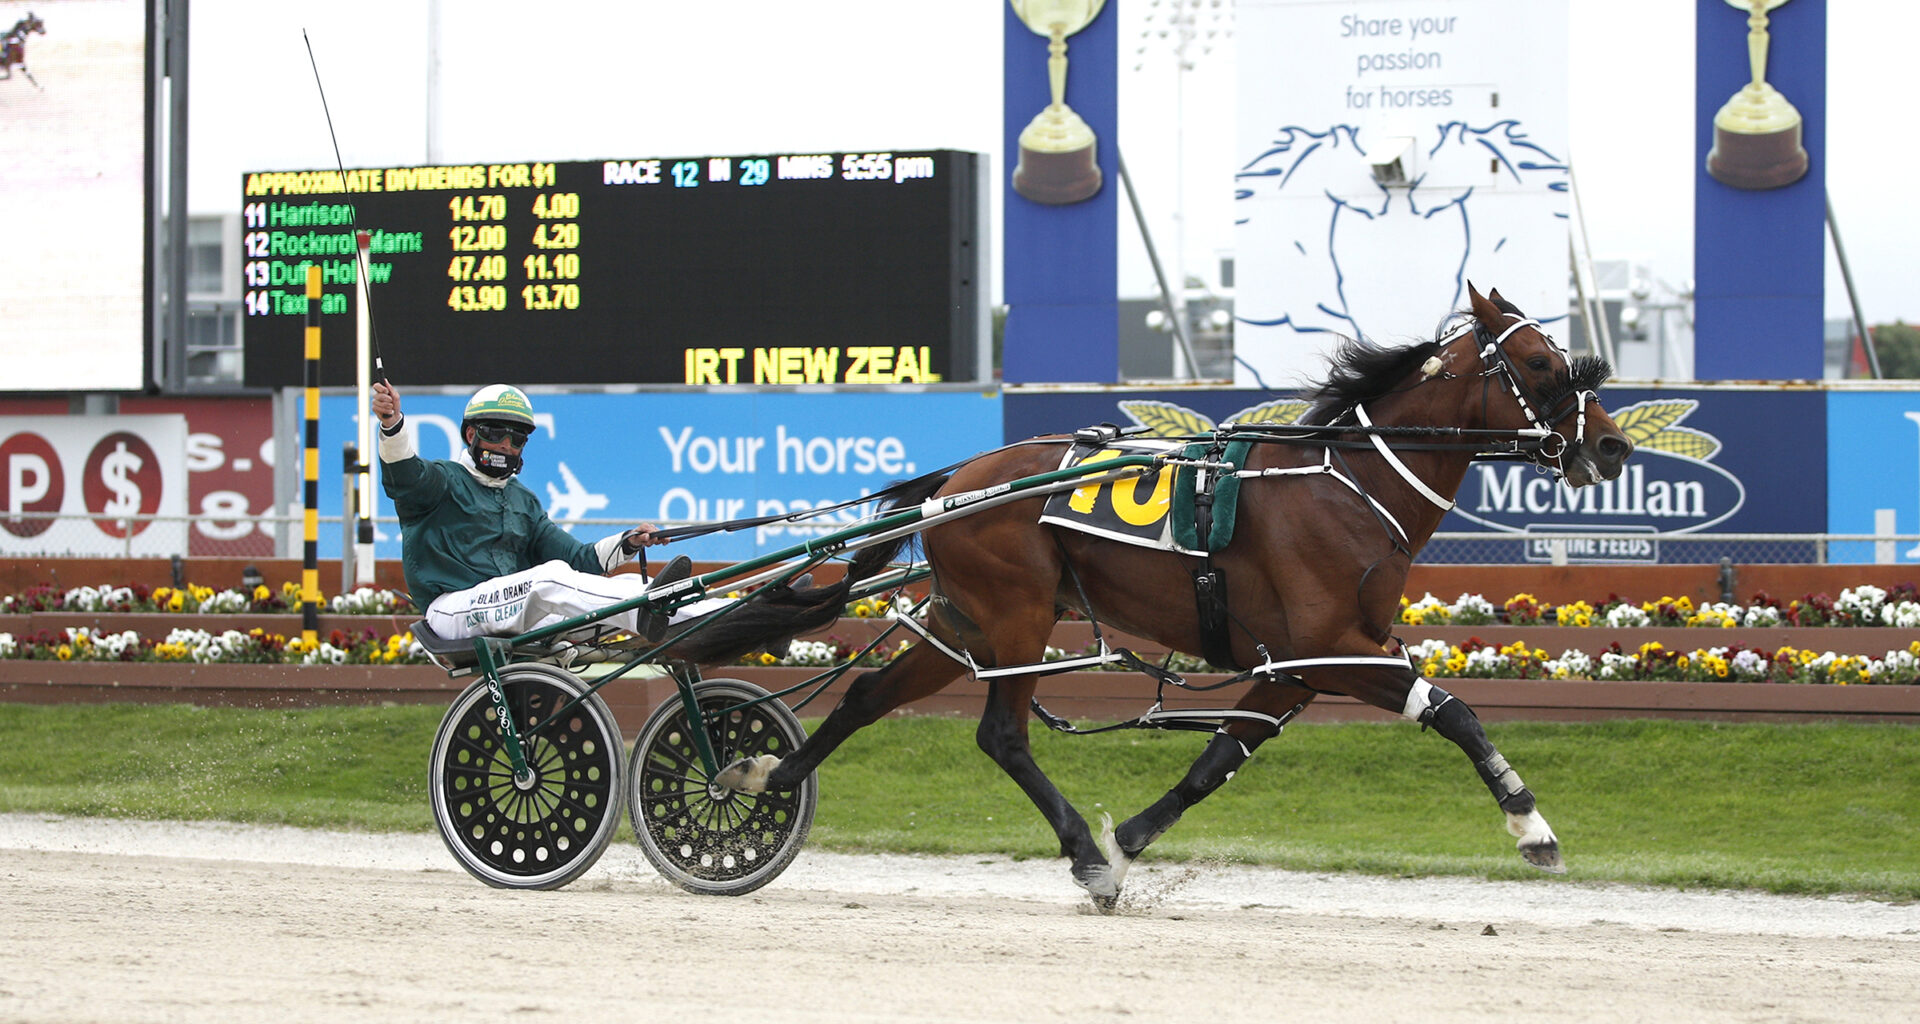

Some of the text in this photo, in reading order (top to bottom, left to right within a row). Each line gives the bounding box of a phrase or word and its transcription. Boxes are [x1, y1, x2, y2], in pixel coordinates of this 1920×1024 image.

[1340, 15, 1458, 40] Share your
[1357, 49, 1442, 77] passion
[1346, 85, 1453, 109] for horses
[246, 162, 556, 197] APPROXIMATE DIVIDENDS FOR $1
[603, 153, 934, 187] RACE 12 IN 29 MINS 5:55 pm
[245, 193, 580, 228] 11 Harrison 14.70 4.00
[245, 232, 270, 257] 12
[450, 225, 507, 251] 12.00
[532, 223, 580, 249] 4.20
[245, 261, 270, 286] 13
[323, 257, 393, 284] Holw
[448, 255, 507, 281] 47.40
[523, 253, 580, 280] 11.10
[245, 284, 580, 316] 14 Taxan 43.90 13.70
[684, 347, 744, 385] IRT
[753, 347, 839, 385] NEW
[659, 425, 916, 475] Your horse.
[9, 453, 50, 524] P
[1068, 449, 1173, 526] 10
[1476, 463, 1708, 517] McMillan
[659, 486, 880, 546] Our passi
[477, 580, 533, 605] BLAIR ORANGE
